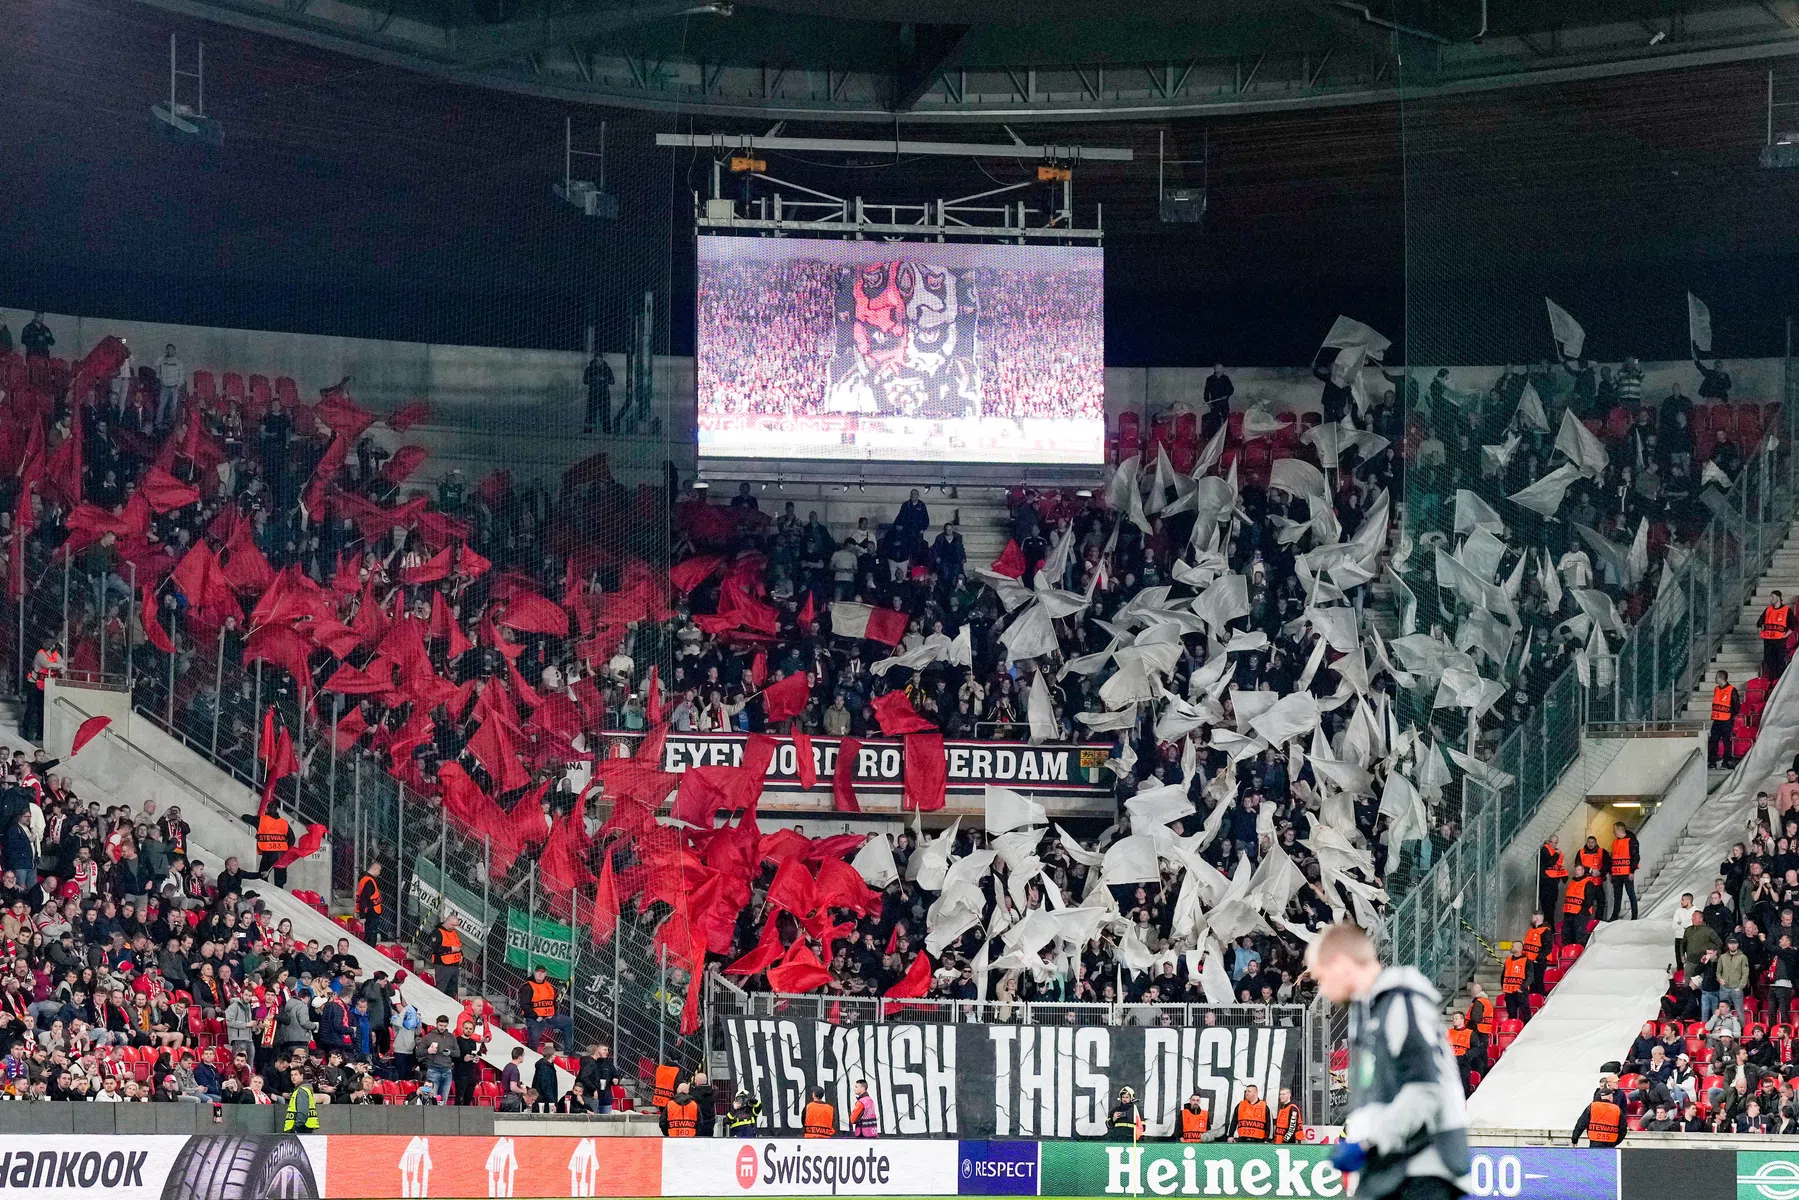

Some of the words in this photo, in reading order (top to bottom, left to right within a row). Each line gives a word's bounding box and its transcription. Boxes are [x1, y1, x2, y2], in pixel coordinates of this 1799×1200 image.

[857, 748, 1069, 781] ROERDAM
[507, 930, 578, 962] FEYNOOR
[989, 1025, 1110, 1137] THIS
[763, 1143, 890, 1195] Swissquote
[975, 1161, 1036, 1178] RESPECT
[1105, 1147, 1343, 1197] Heineke
[1470, 1153, 1521, 1197] 0.0
